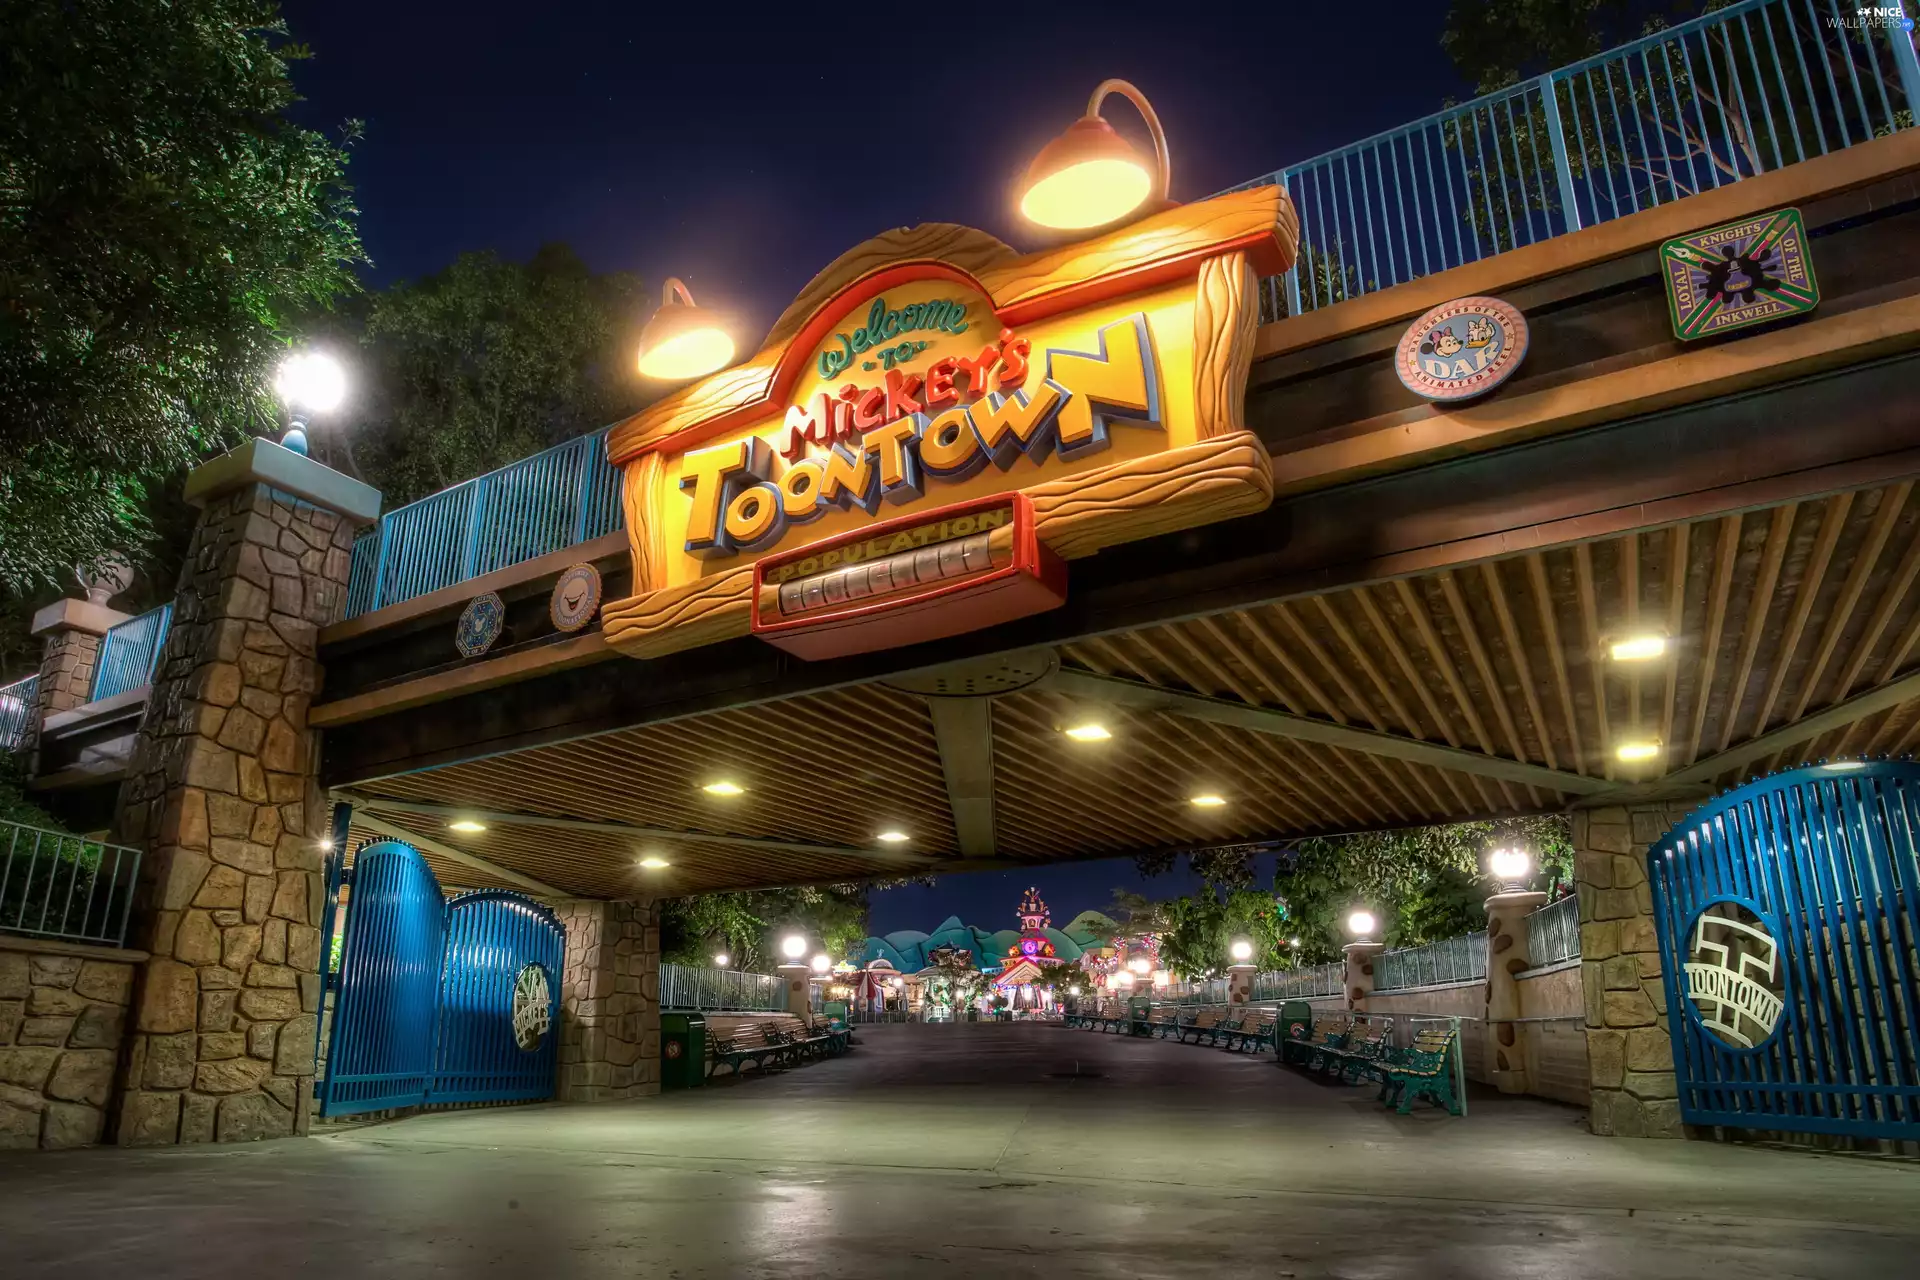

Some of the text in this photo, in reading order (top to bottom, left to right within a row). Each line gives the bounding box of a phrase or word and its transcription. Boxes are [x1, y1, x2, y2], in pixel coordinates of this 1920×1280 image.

[1699, 222, 1762, 247] KNIGHTS
[1782, 238, 1803, 282] OF THE
[1674, 267, 1692, 310] LOYAL
[1409, 306, 1510, 352] DAUGHTERS OF THE
[1715, 302, 1781, 326] INKWELL
[817, 297, 969, 380] Welcome
[1424, 341, 1500, 379] DAR
[1414, 346, 1512, 389] ANIMATED REEL
[679, 312, 1167, 558] TOONTOWN
[778, 509, 1004, 582] POPULATION
[1685, 966, 1783, 1034] TOONTOWN
